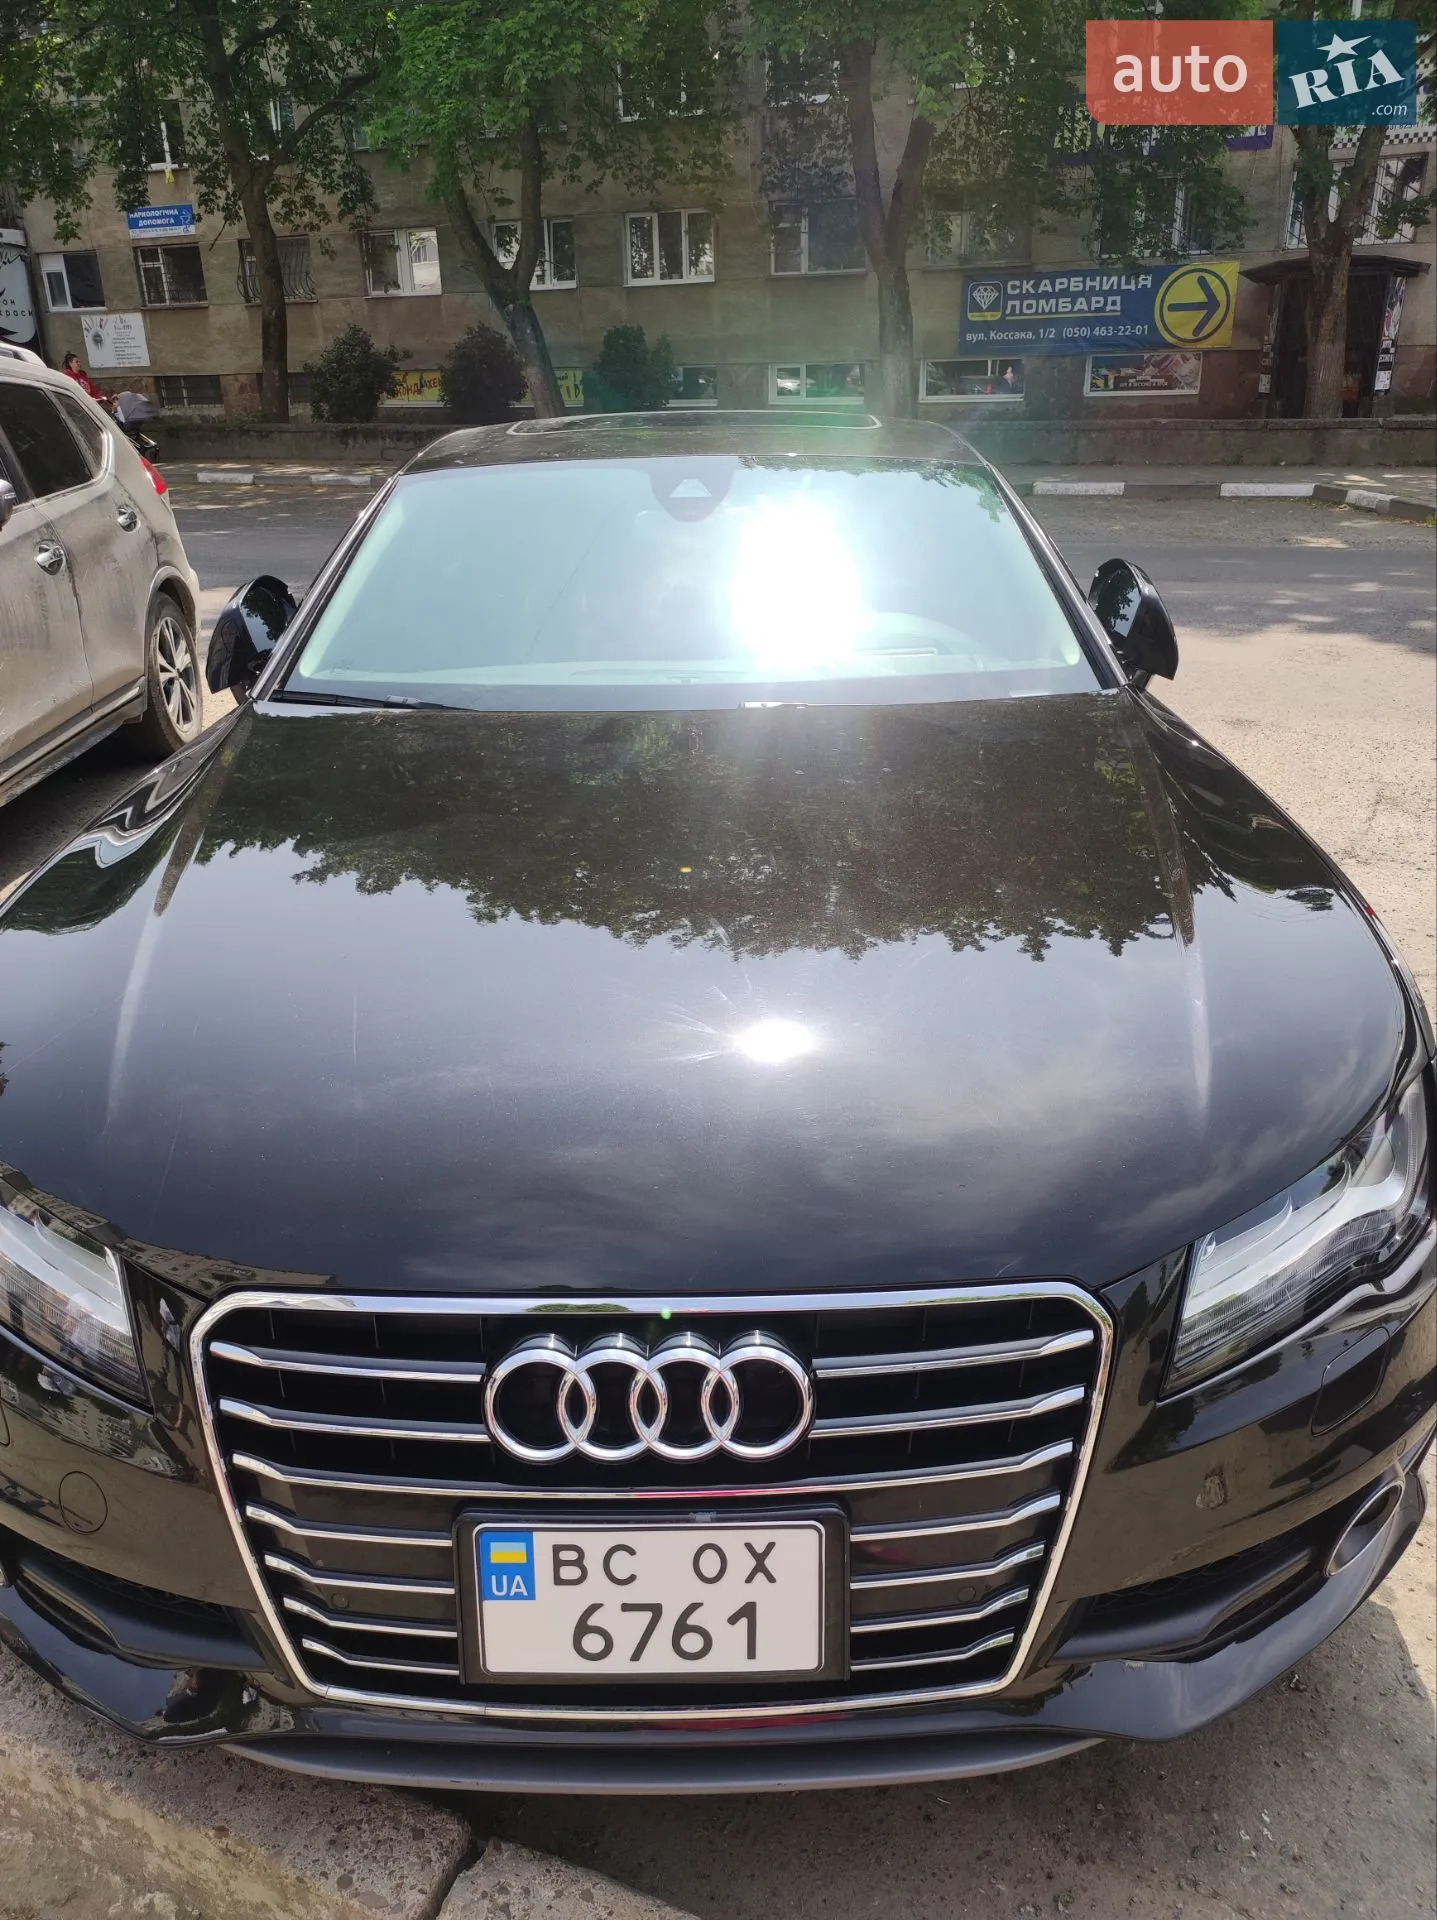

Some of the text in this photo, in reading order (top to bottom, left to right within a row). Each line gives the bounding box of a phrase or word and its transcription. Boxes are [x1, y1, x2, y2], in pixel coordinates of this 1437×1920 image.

[138, 217, 175, 227] ДОПОМОГА
[1006, 274, 1152, 295] СКАРБНИЦЯ
[1005, 295, 1122, 314] ЛОМБАРД
[966, 324, 1149, 344] вул. Коссака, 1/2 (050) 463-22-01
[552, 1541, 777, 1586] BC OX
[490, 1574, 529, 1597] UA
[572, 1601, 757, 1662] 6761
